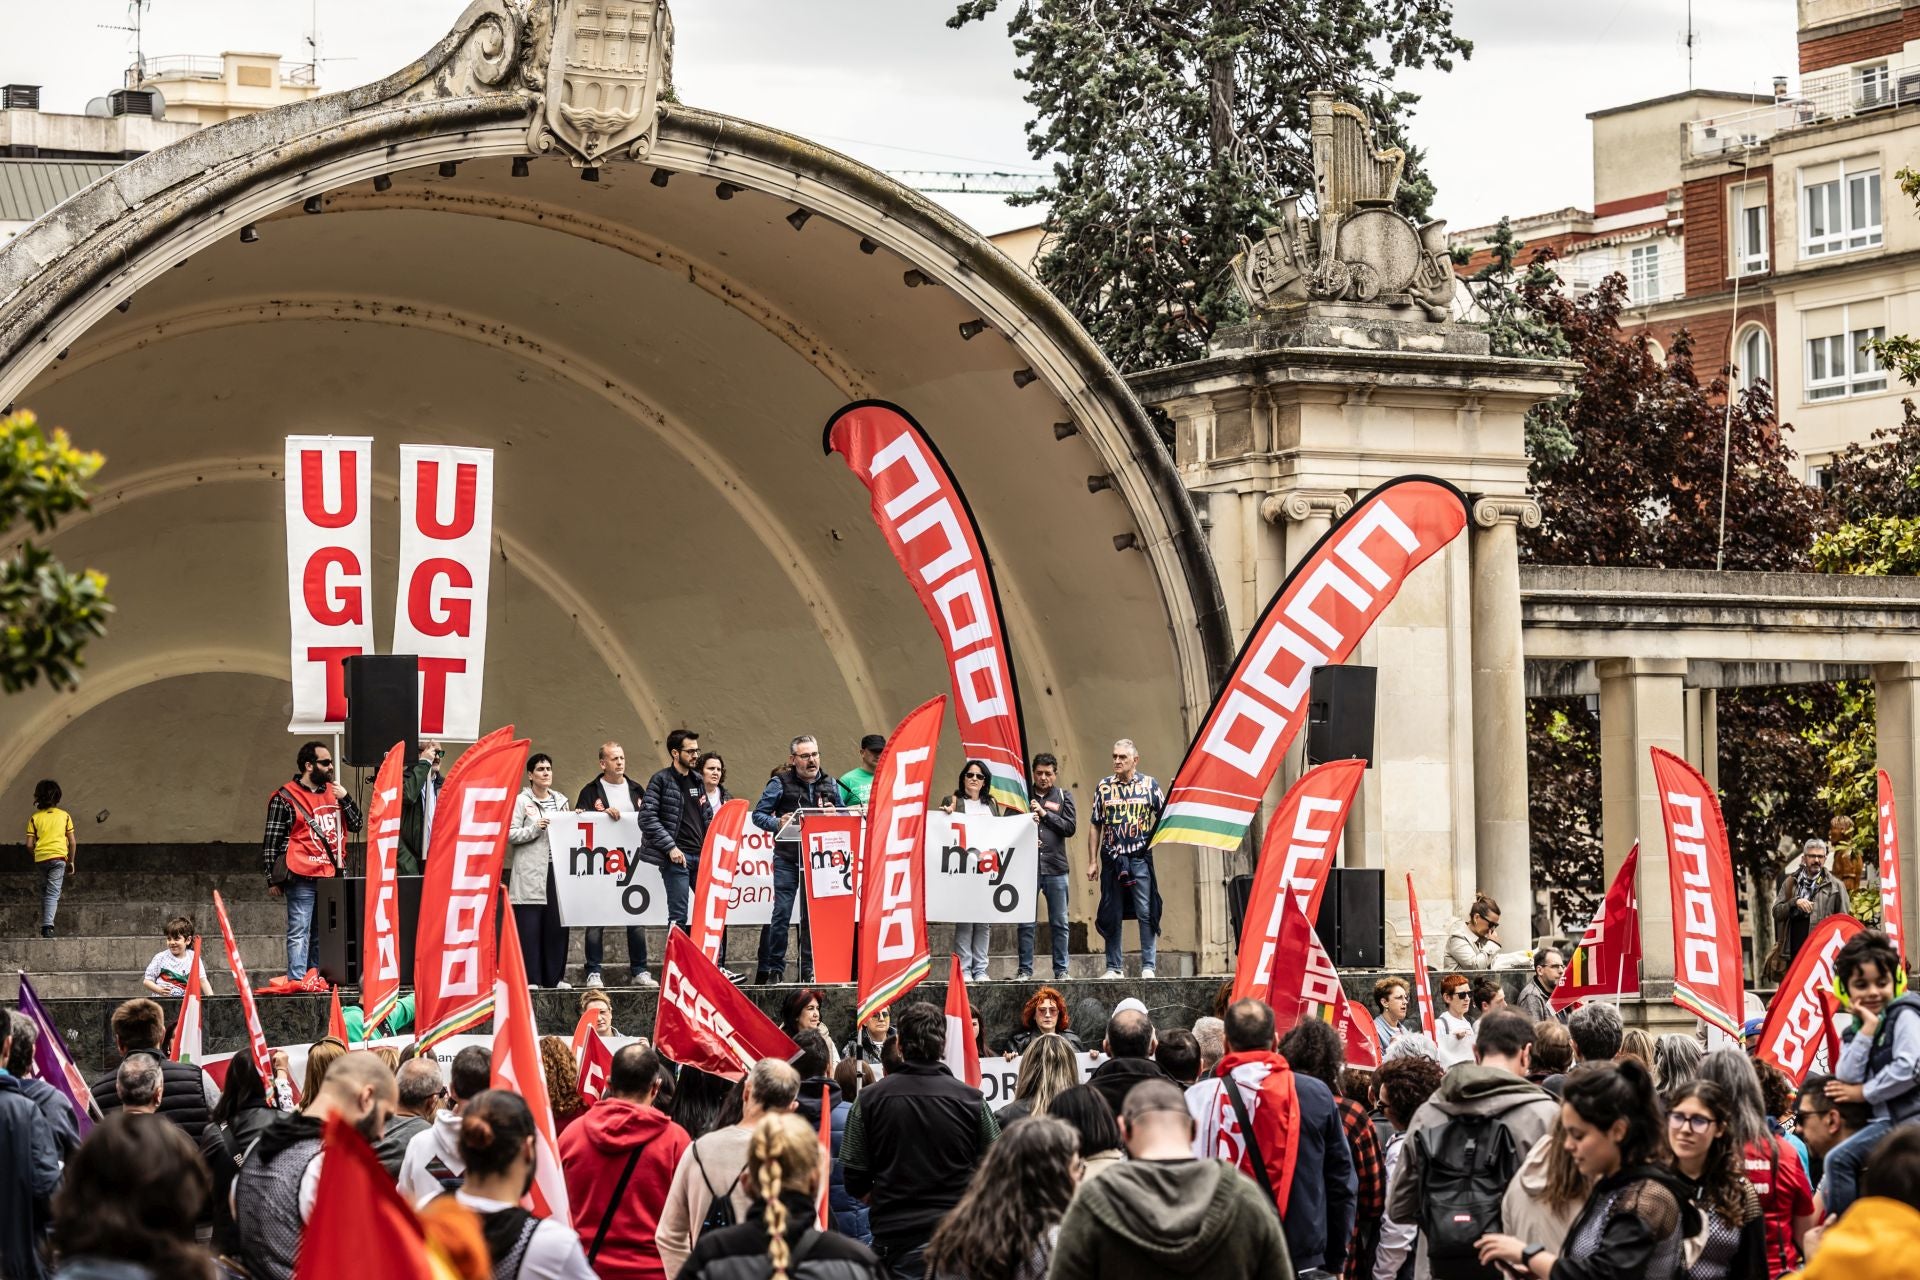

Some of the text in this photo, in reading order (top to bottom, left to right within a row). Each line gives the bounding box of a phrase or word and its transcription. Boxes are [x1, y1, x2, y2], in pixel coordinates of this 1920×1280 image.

[301, 450, 363, 722] UGT
[407, 461, 476, 733] UGT
[1202, 499, 1421, 779] CCOO
[439, 786, 508, 998] CCOO
[727, 886, 774, 909] gan
[740, 831, 775, 849] rot
[878, 746, 930, 963] CCOO
[1253, 795, 1343, 985] CC
